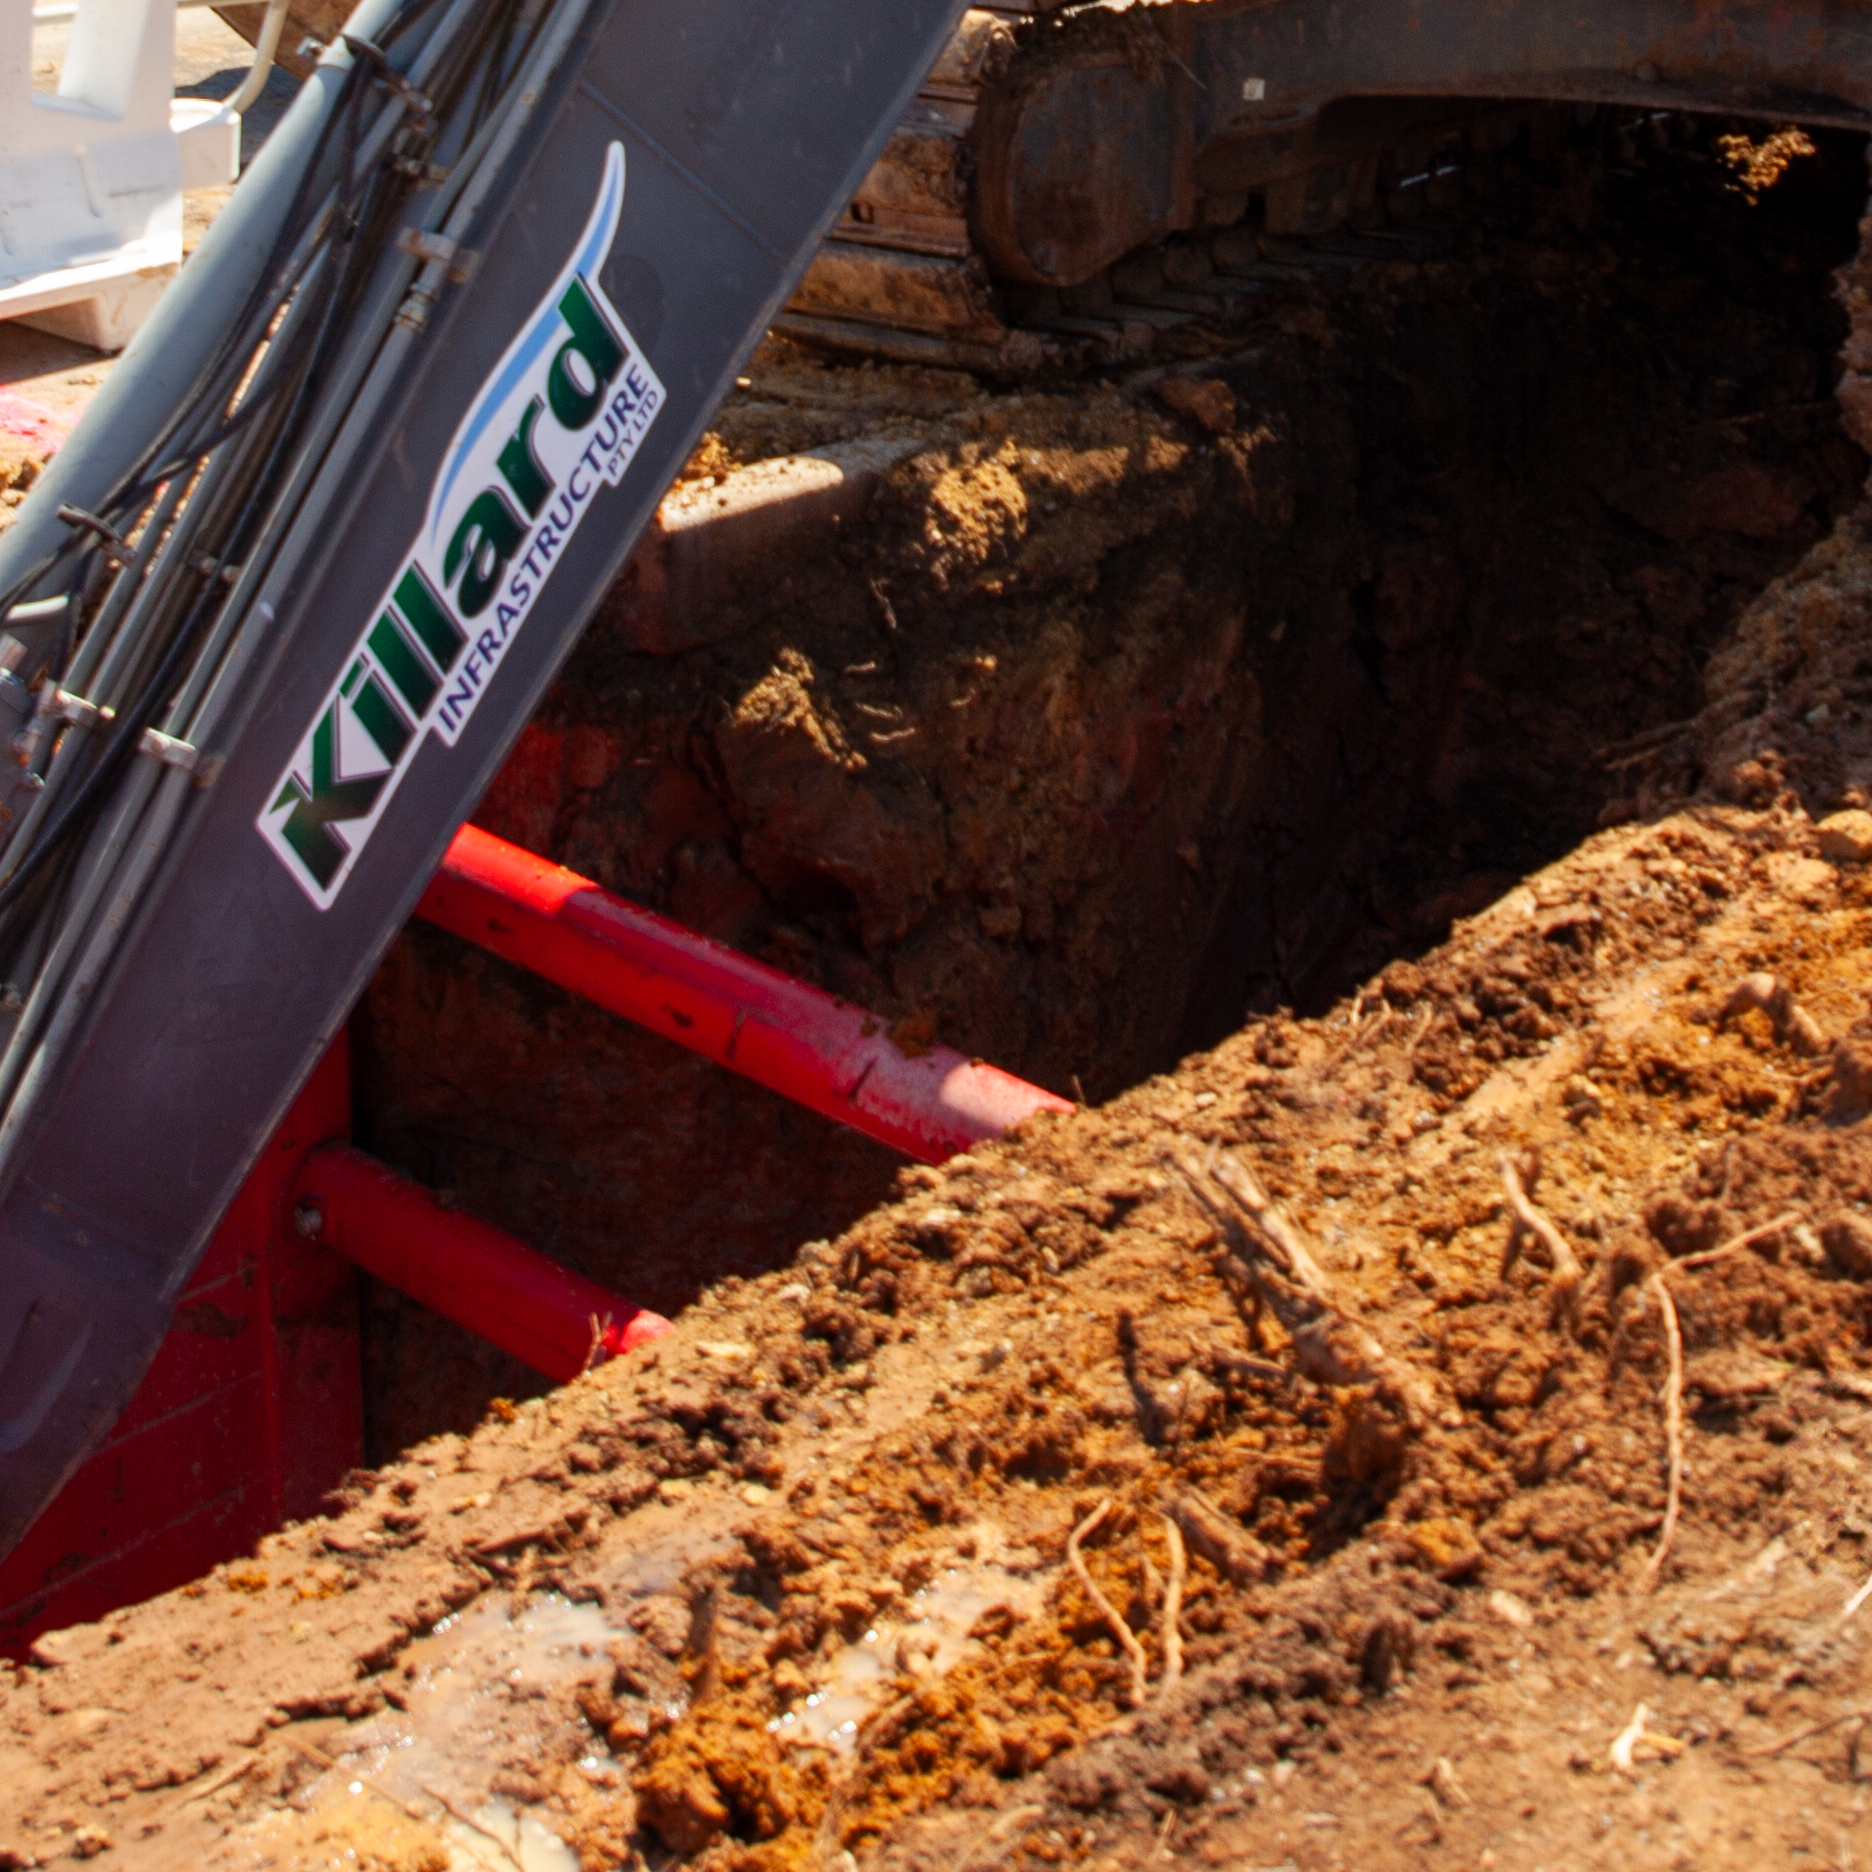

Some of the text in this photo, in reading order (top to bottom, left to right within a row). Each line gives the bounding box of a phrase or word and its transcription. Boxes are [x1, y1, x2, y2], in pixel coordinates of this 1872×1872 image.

[270, 271, 629, 893] Killard
[438, 362, 649, 733] INFRASTRUCTURE
[607, 389, 658, 477] PTY LTD
